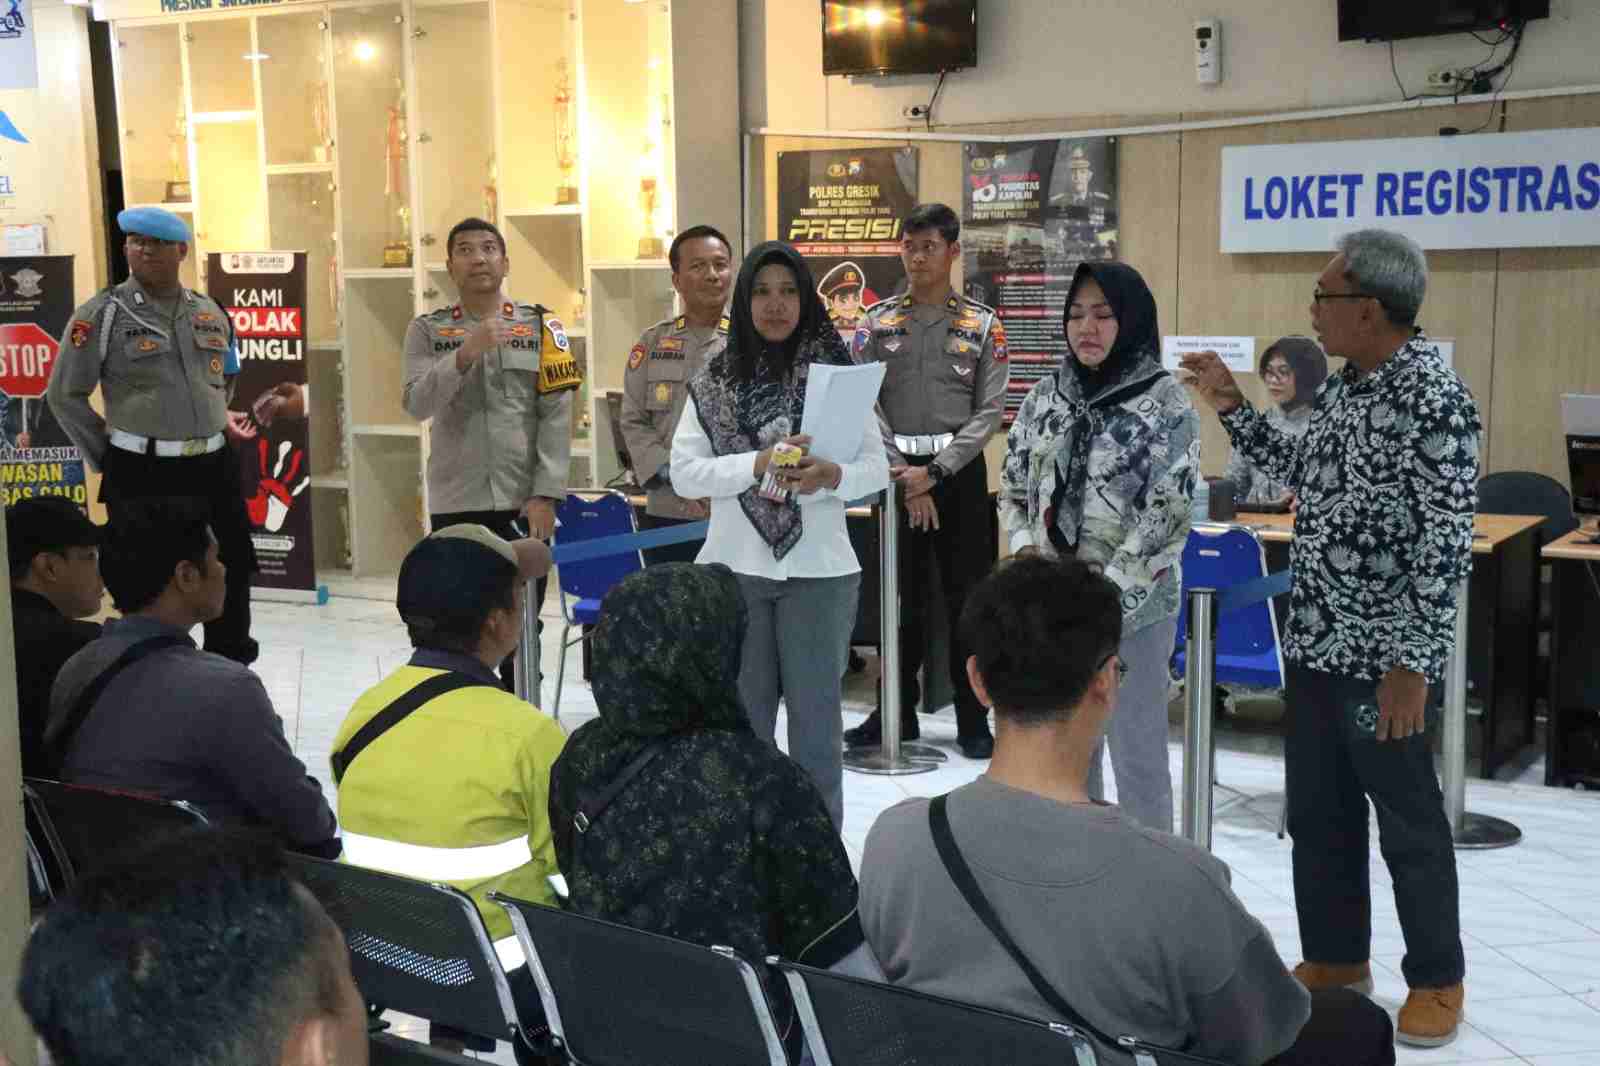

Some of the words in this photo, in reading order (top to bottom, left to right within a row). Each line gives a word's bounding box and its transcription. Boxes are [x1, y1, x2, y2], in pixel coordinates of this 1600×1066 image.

[809, 186, 844, 199] POLRES
[846, 185, 880, 198] GRESIK
[1244, 173, 1363, 220] LOKET
[1375, 162, 1600, 217] REGISTRAS
[788, 218, 900, 240] PRESISI
[233, 288, 282, 307] KAMI
[240, 338, 303, 361] UNGLI
[507, 339, 539, 351] OLRI
[0, 344, 51, 377] STOP
